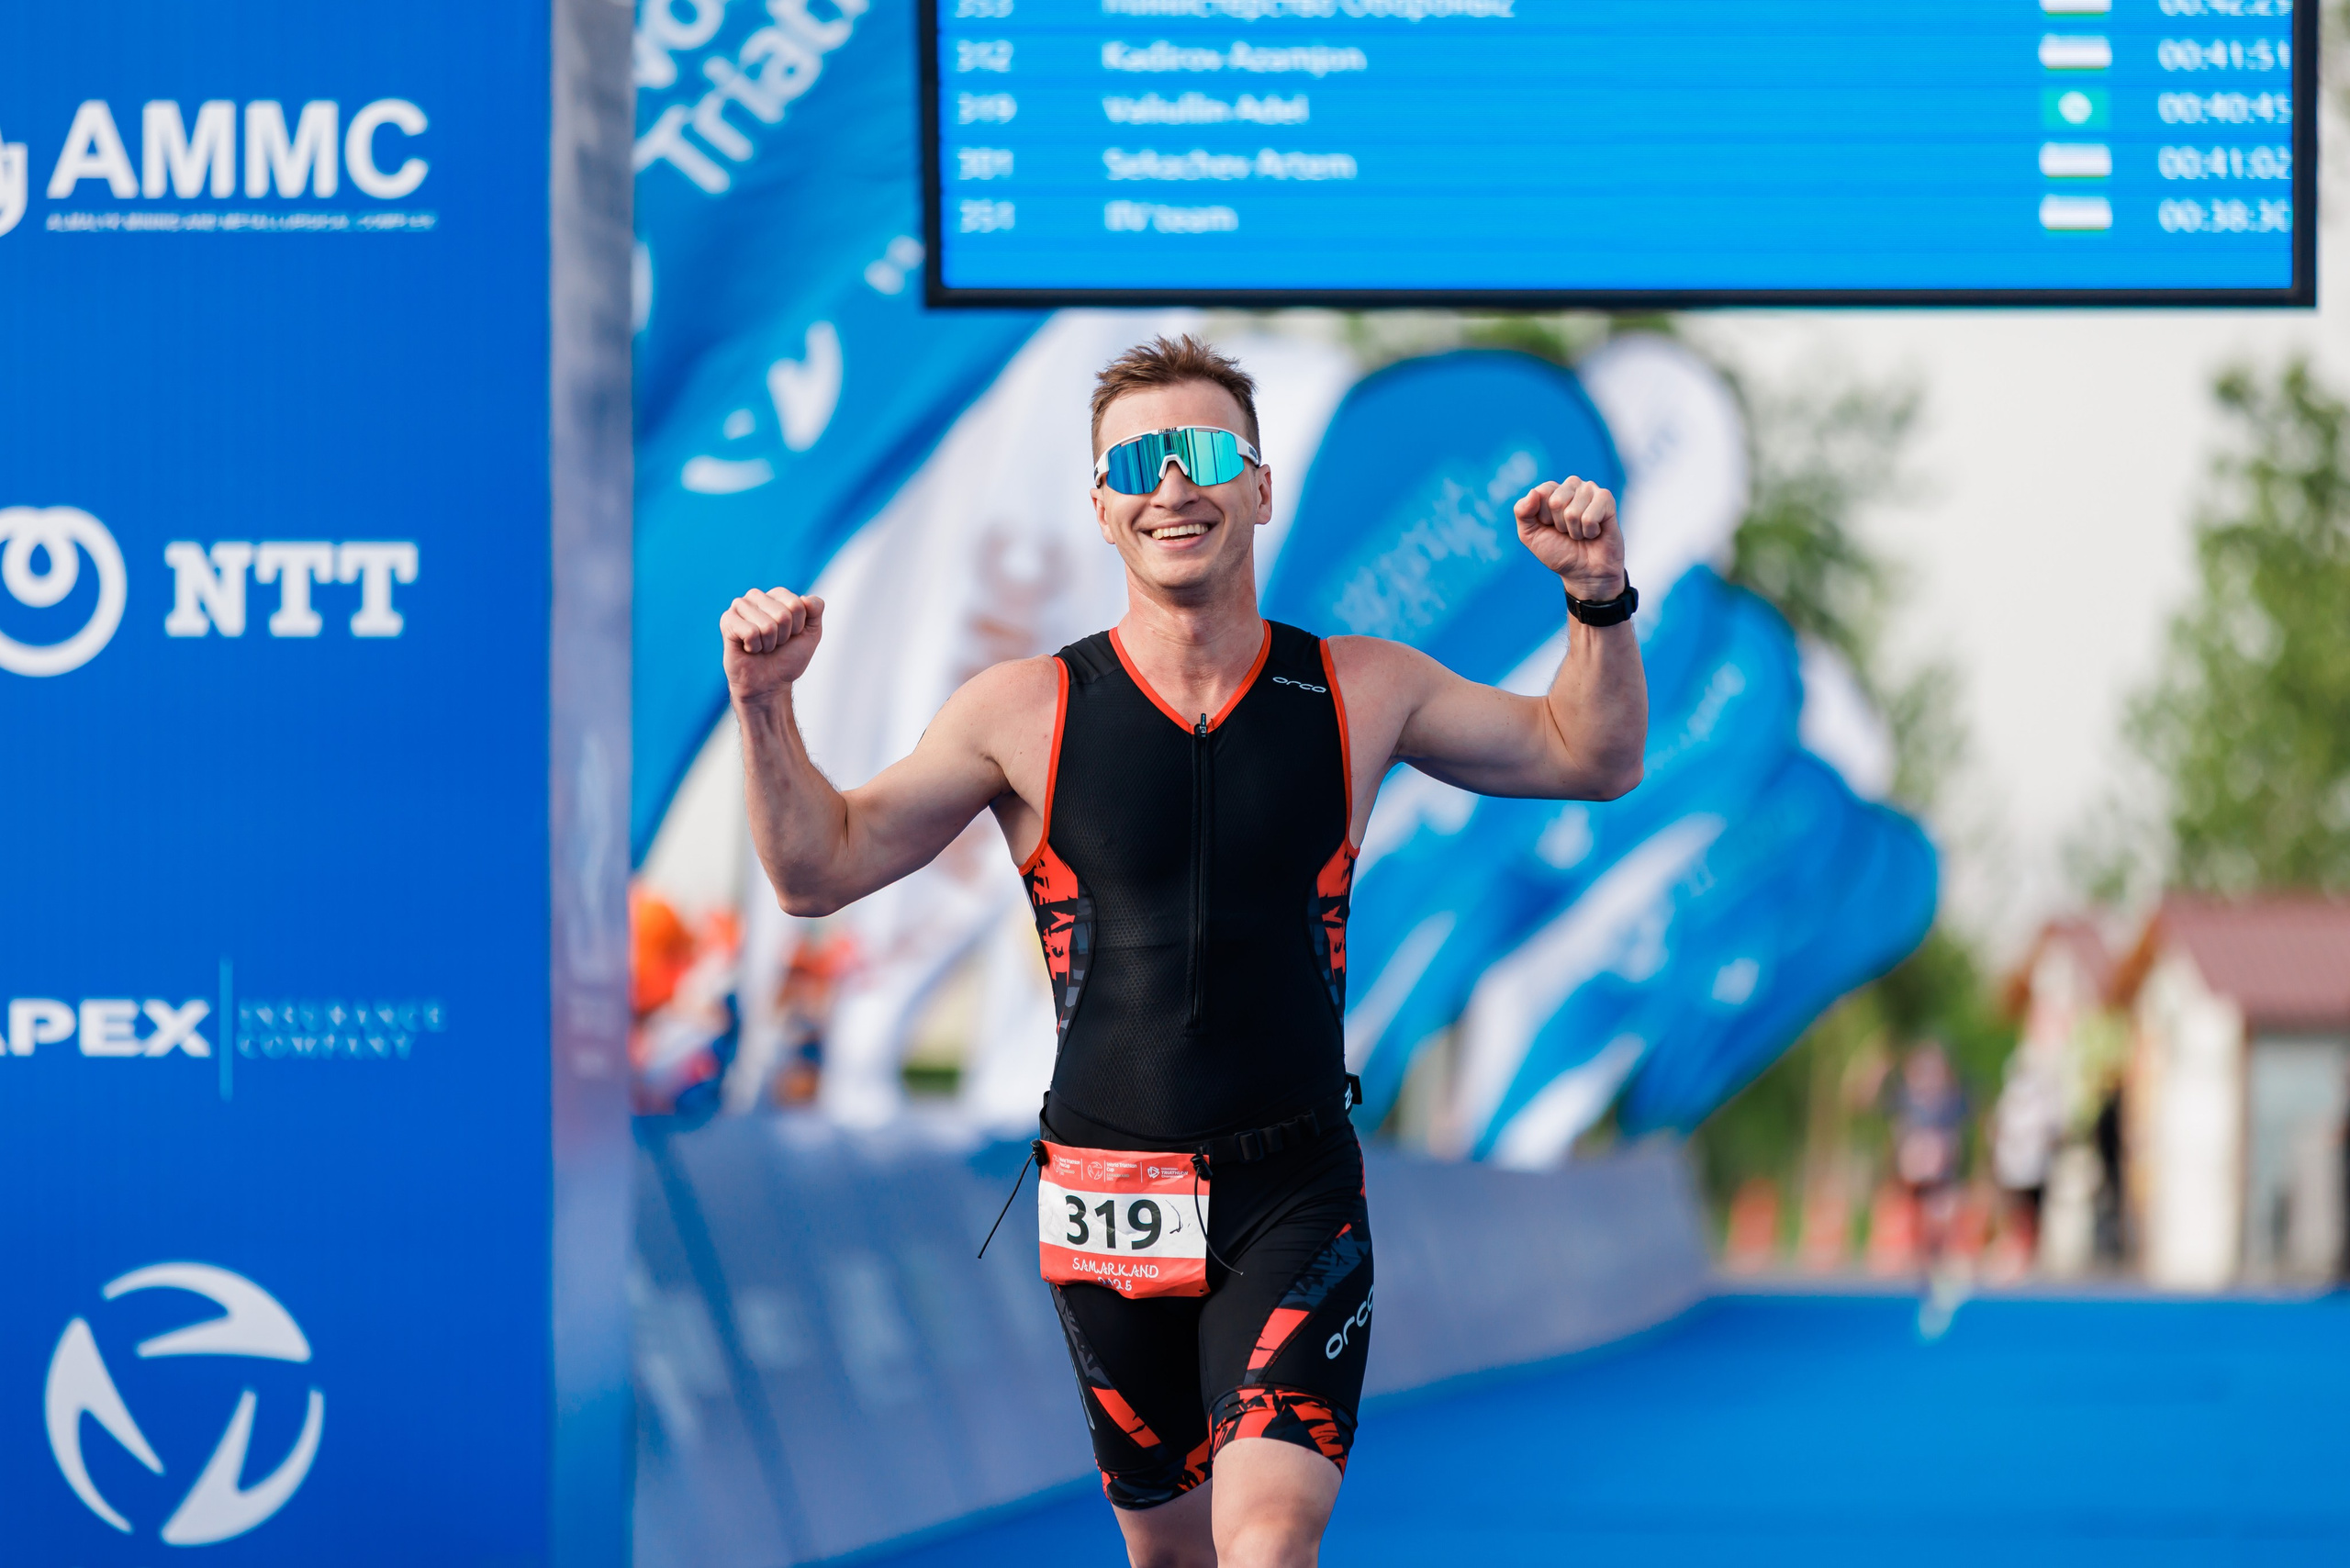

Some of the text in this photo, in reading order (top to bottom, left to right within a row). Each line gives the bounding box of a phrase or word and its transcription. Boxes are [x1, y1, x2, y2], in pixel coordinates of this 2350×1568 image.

[46, 99, 429, 199] AMMC
[165, 541, 420, 637] NTT
[1272, 677, 1326, 693] orca
[0, 998, 211, 1058] PEX
[1066, 1194, 1162, 1251] 319
[1072, 1257, 1159, 1279] SAMARKAND
